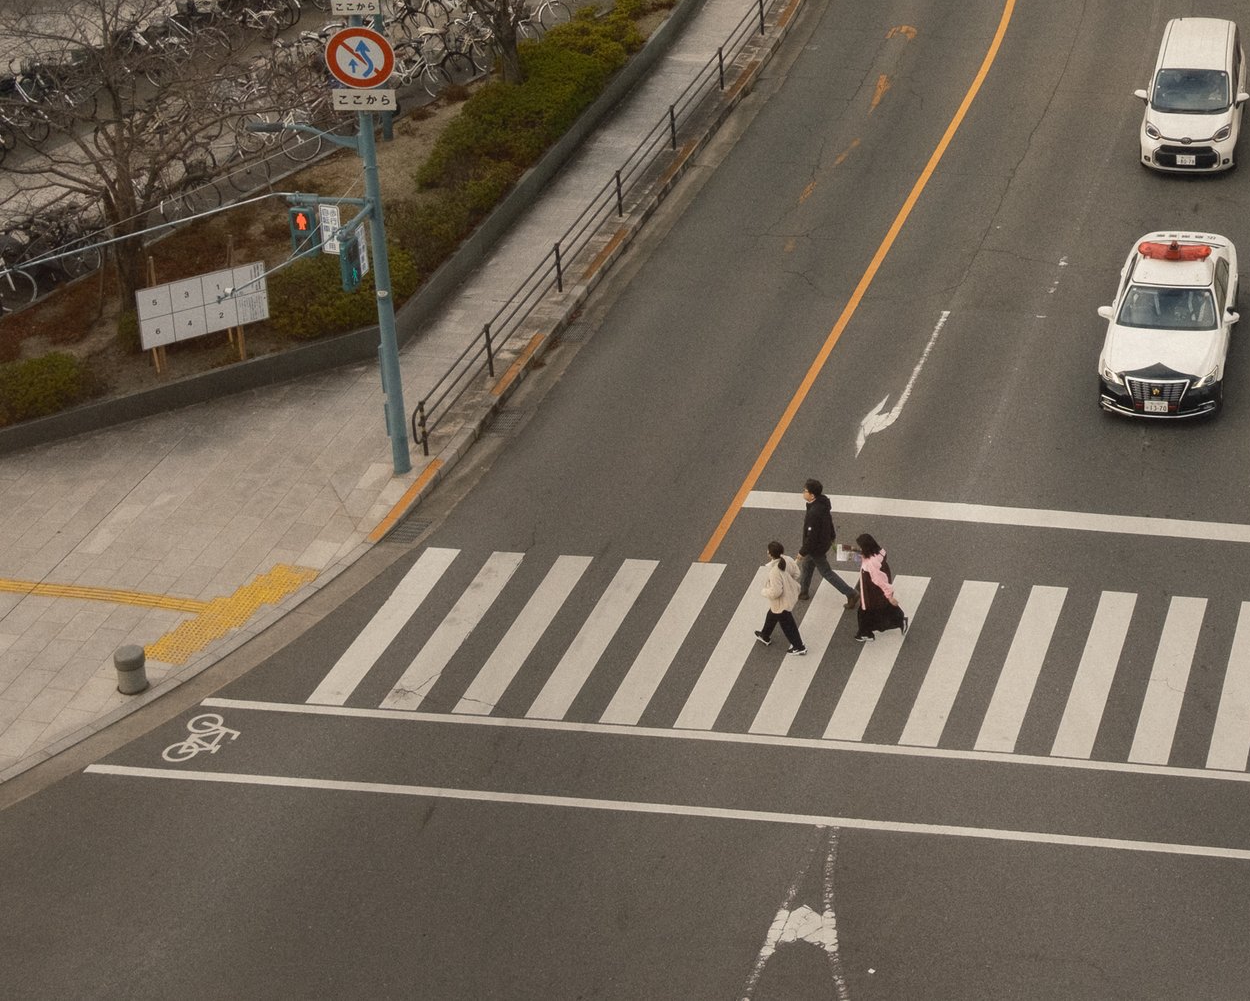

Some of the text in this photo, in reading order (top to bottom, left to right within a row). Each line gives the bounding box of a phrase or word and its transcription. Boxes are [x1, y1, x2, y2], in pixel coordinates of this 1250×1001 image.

[335, 1, 376, 12] ここから
[338, 94, 391, 106] ここから
